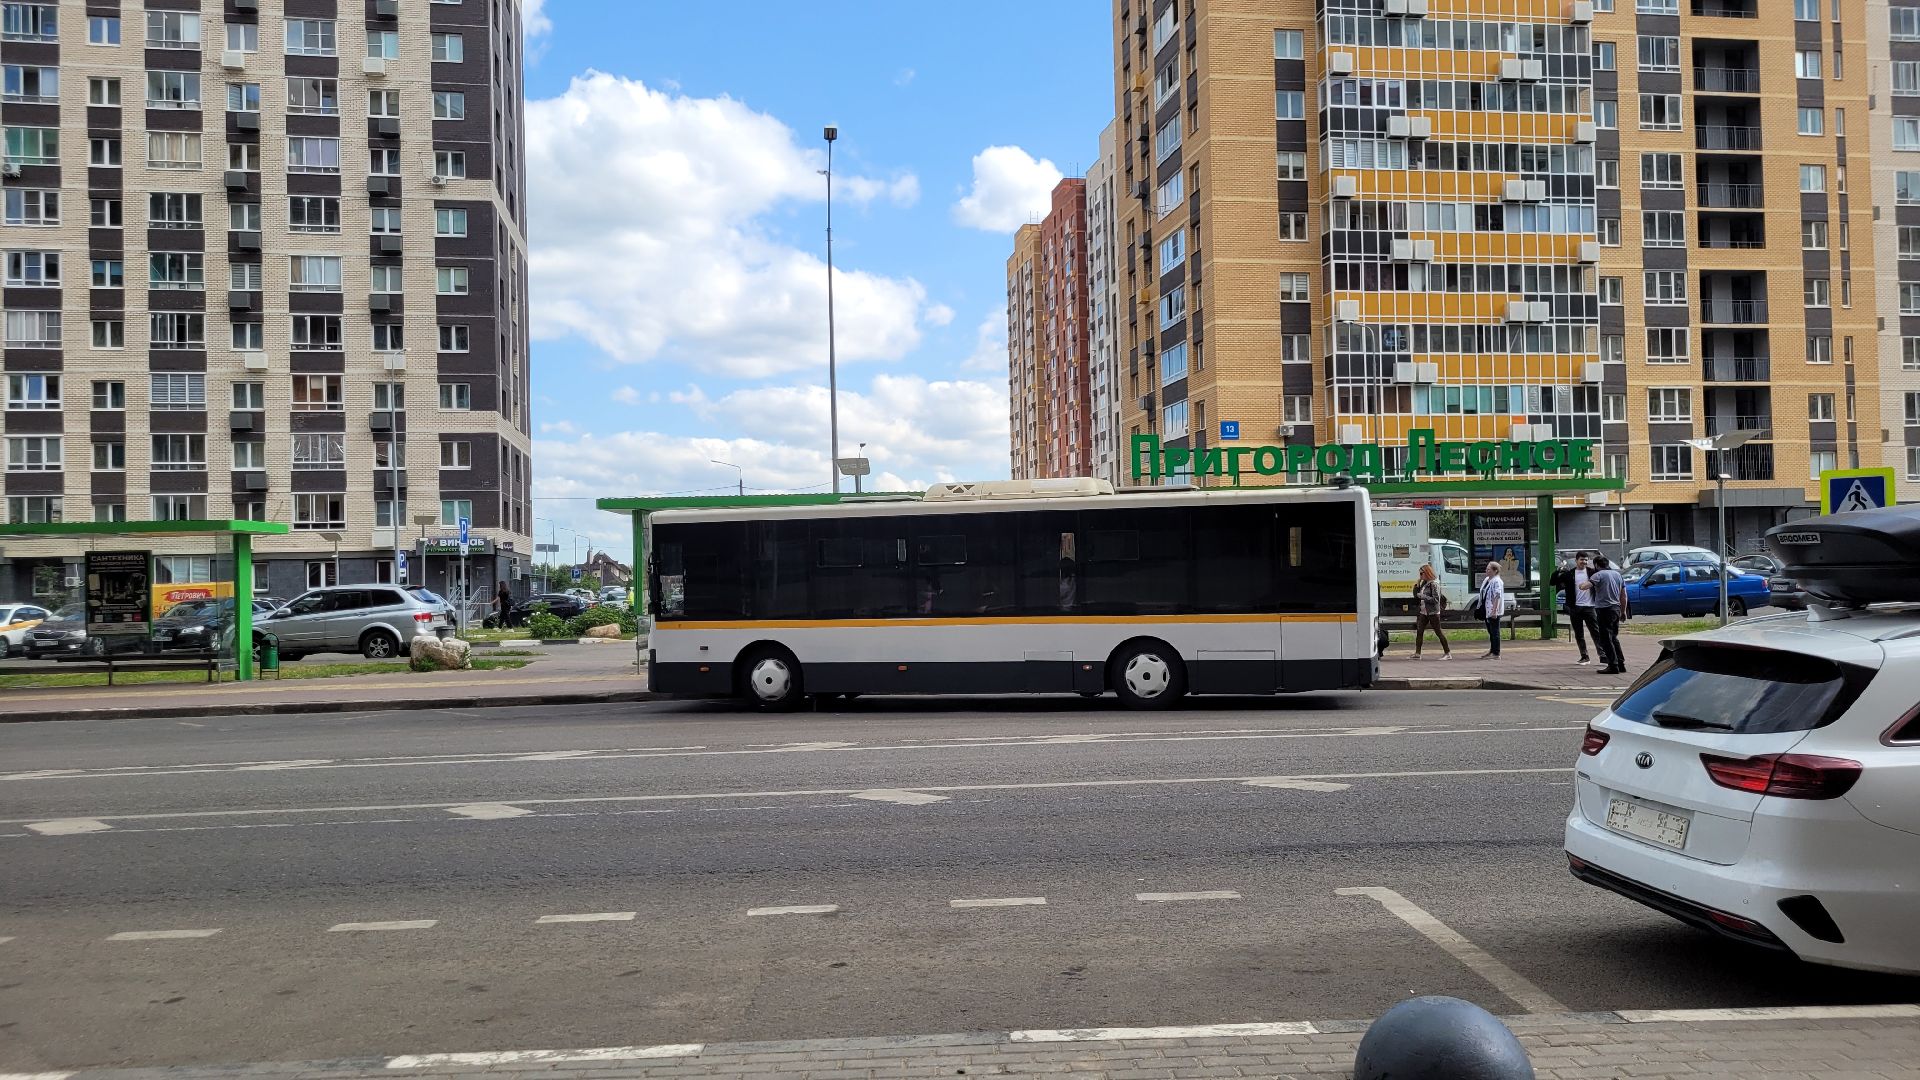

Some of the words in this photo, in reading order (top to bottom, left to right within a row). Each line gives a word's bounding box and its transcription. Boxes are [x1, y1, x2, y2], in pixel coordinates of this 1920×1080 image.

[1225, 425, 1235, 433] 13
[440, 538, 485, 547] ВИНАБ
[1779, 534, 1819, 543] BROOMER
[91, 554, 145, 562] САНТЕХНИКА
